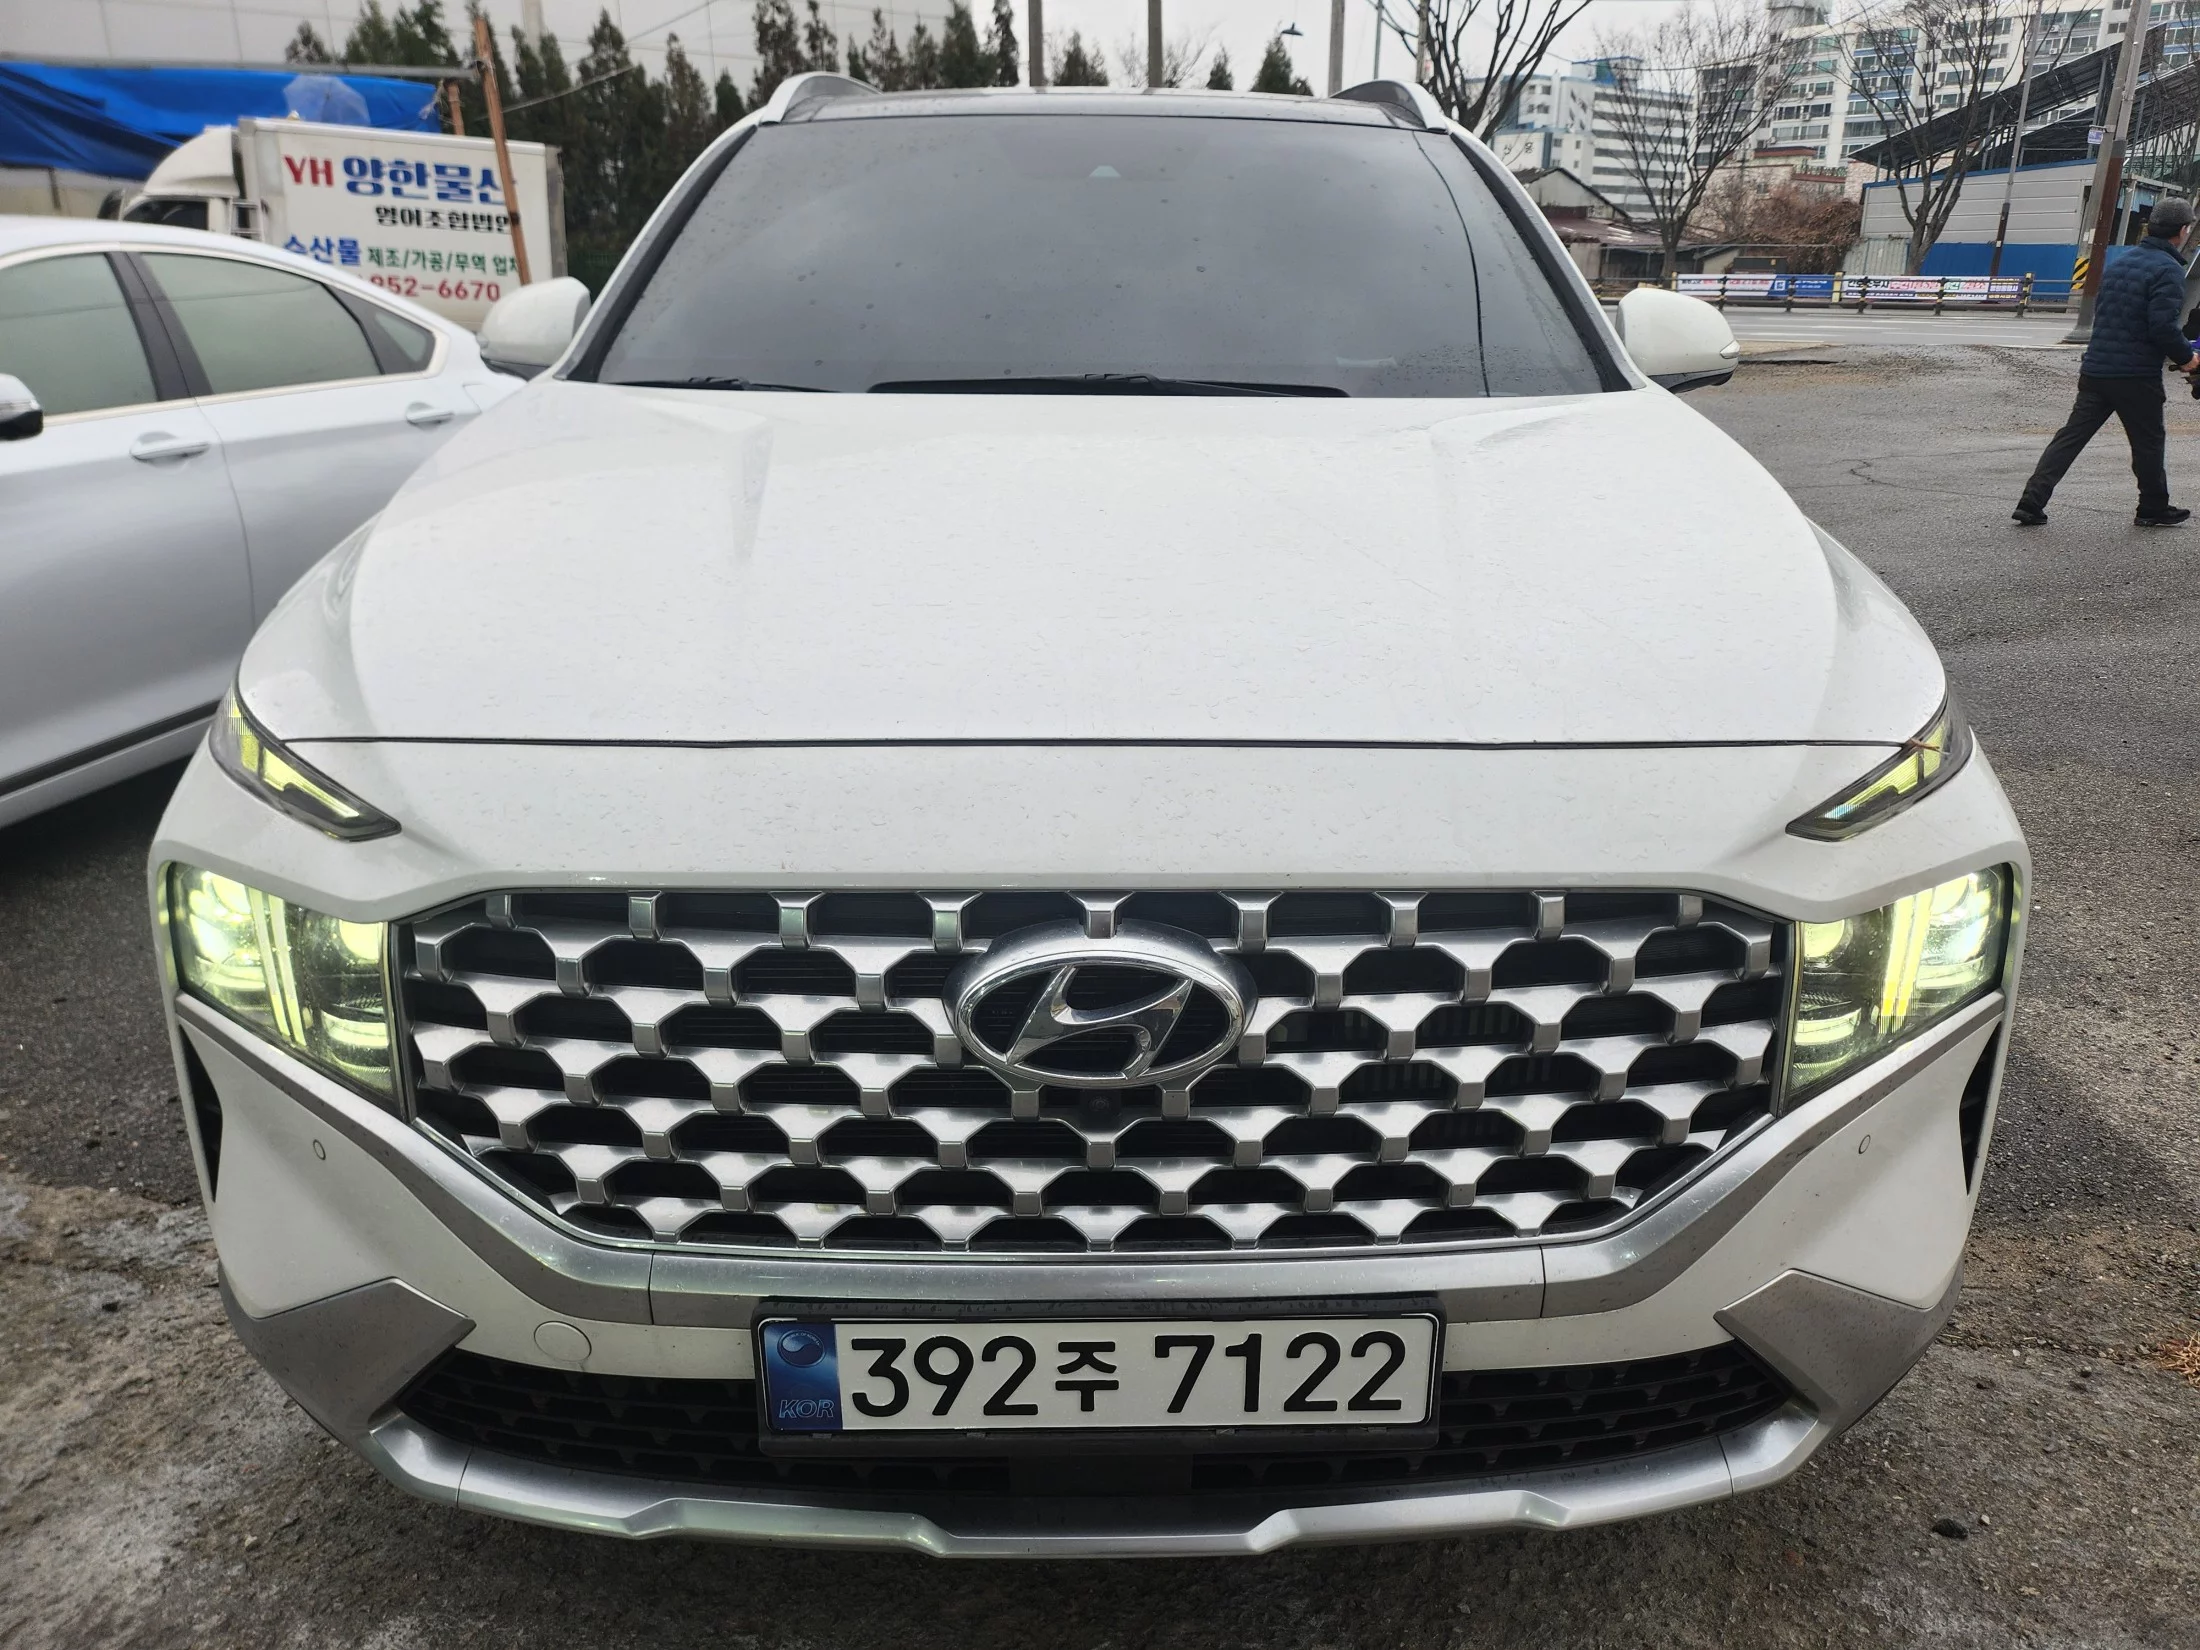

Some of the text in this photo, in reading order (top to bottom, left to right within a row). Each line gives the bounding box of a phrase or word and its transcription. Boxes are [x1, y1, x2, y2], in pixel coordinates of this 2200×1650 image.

[284, 155, 334, 187] YH
[343, 155, 508, 206] 양한물산
[851, 1331, 1407, 1418] 392주 7122
[779, 1399, 834, 1418] KOR
